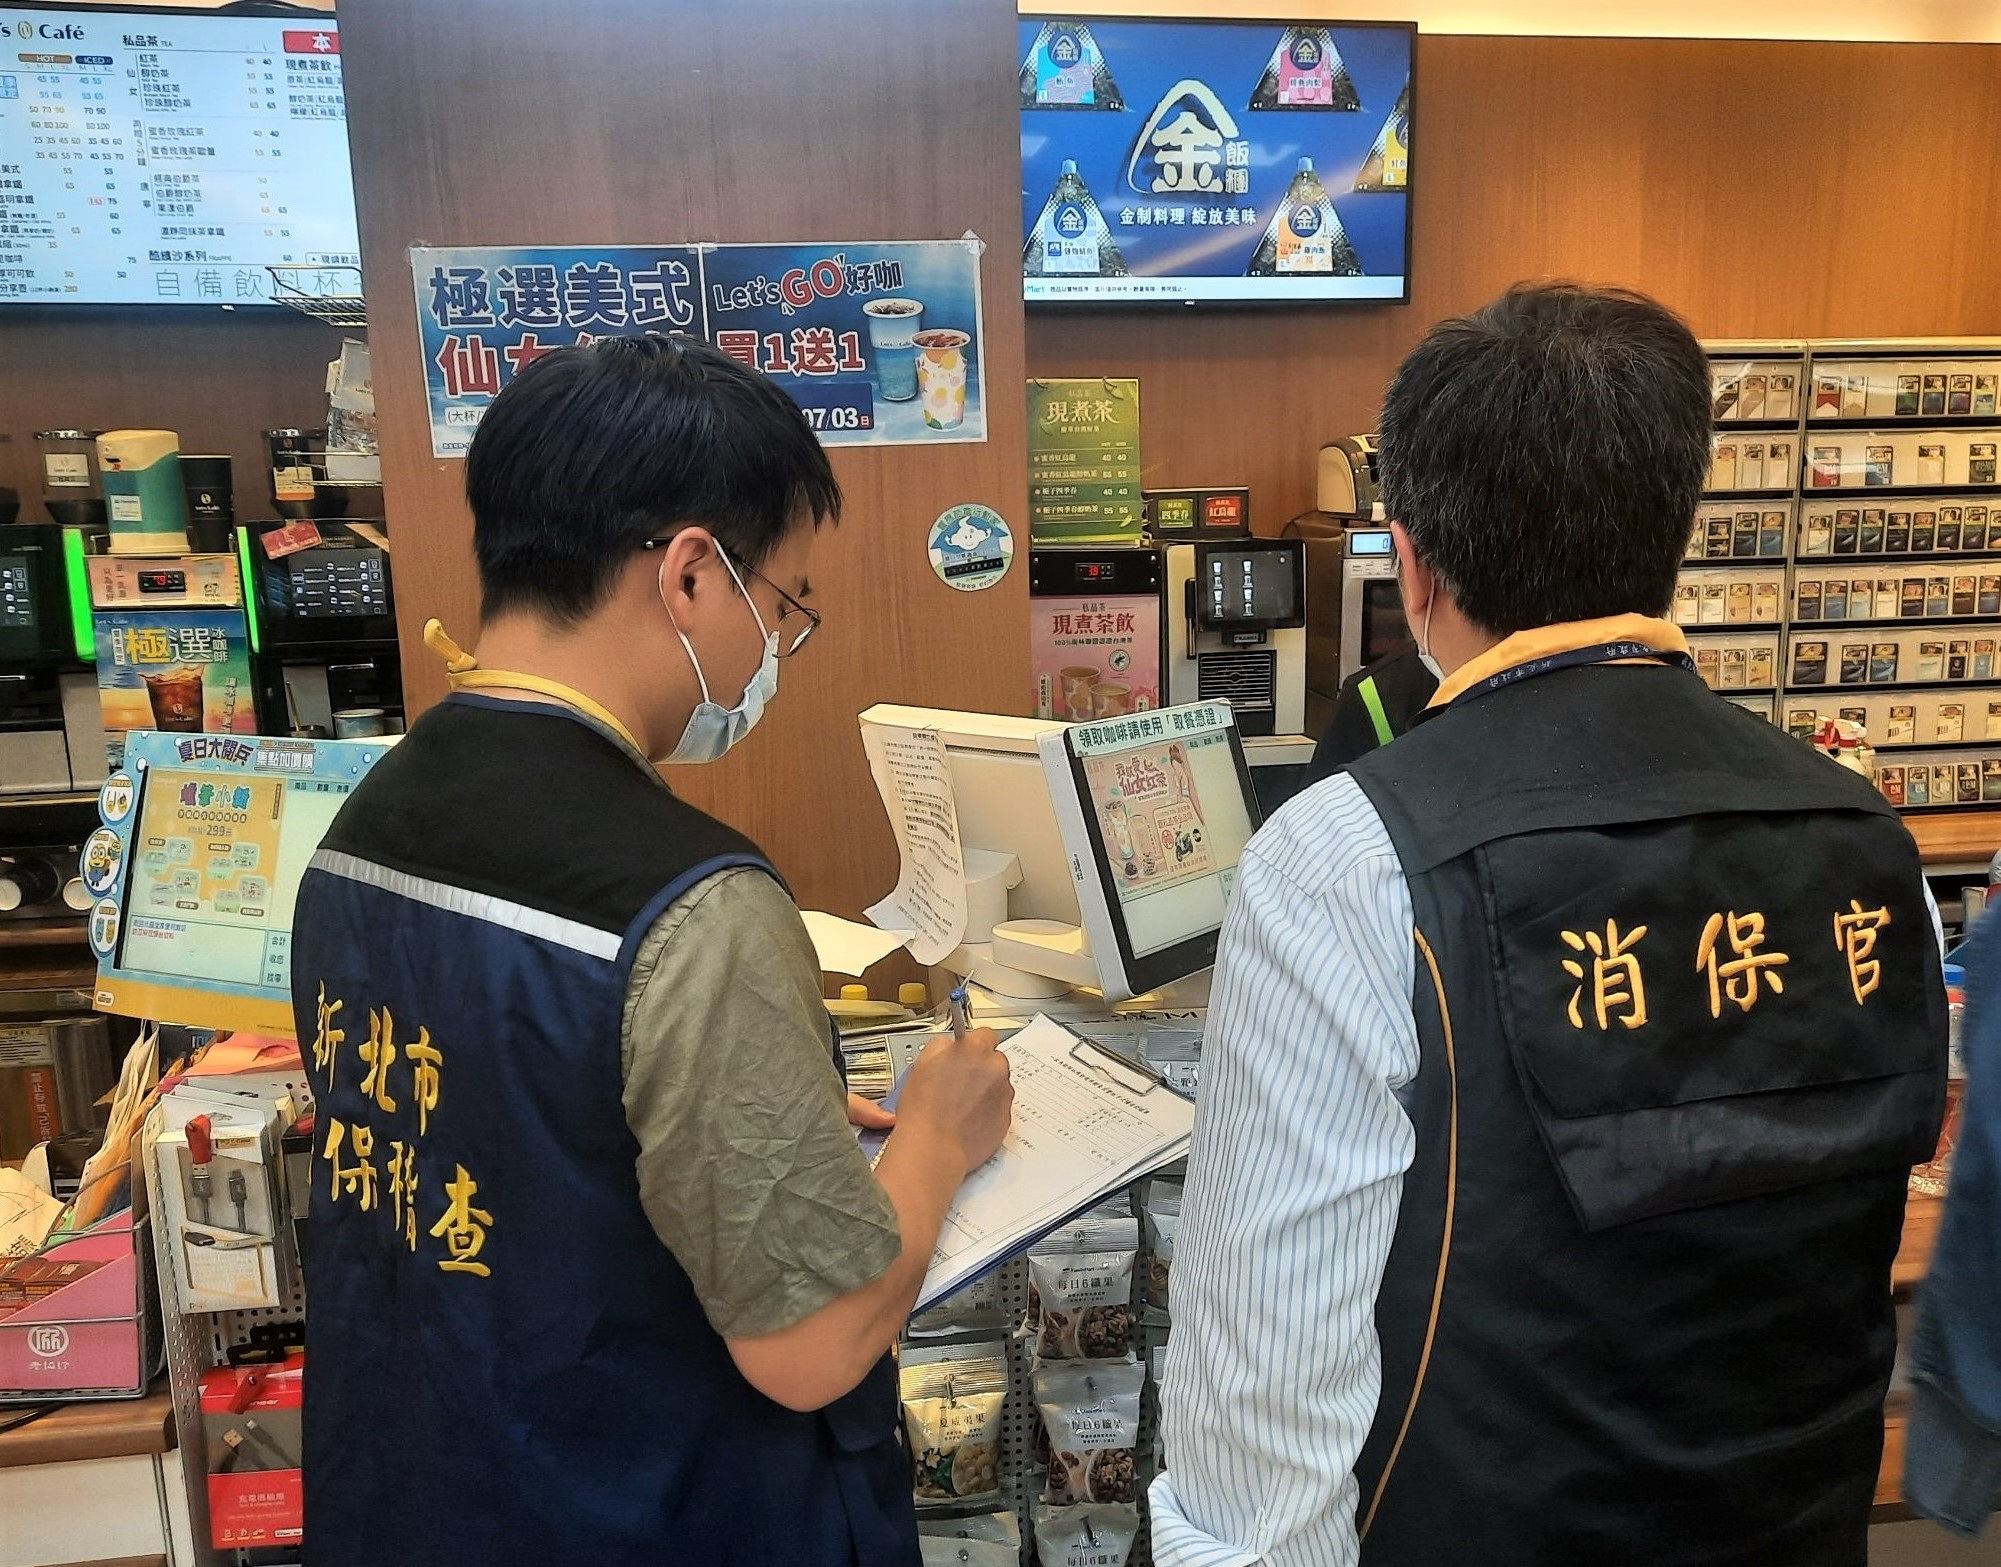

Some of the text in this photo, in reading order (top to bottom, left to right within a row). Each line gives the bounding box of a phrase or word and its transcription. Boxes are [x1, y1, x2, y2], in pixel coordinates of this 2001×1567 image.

[38, 23, 85, 40] Café
[122, 35, 158, 47] 私品茶
[36, 55, 56, 63] HOT
[1150, 112, 1224, 194] 金
[1225, 140, 1250, 195] 飯糰
[1119, 207, 1258, 226] 金制料理 綻放美味
[429, 261, 695, 329] 極選美式
[712, 257, 905, 313] Let's GO 好咖
[717, 328, 867, 377] 買1送1
[1045, 399, 1120, 425] 現煮茶
[1102, 454, 1112, 462] 40
[1117, 470, 1128, 478] 55
[1103, 488, 1113, 496] 40
[1104, 507, 1114, 515] 55
[1119, 506, 1129, 514] 55
[1052, 613, 1135, 635] 現煮茶飲
[125, 628, 214, 665] 極選
[211, 626, 229, 663] 冰咖啡
[180, 738, 254, 766] 夏日大閱兵
[1560, 899, 1892, 1031] 消保官
[312, 979, 444, 1137] 新北市
